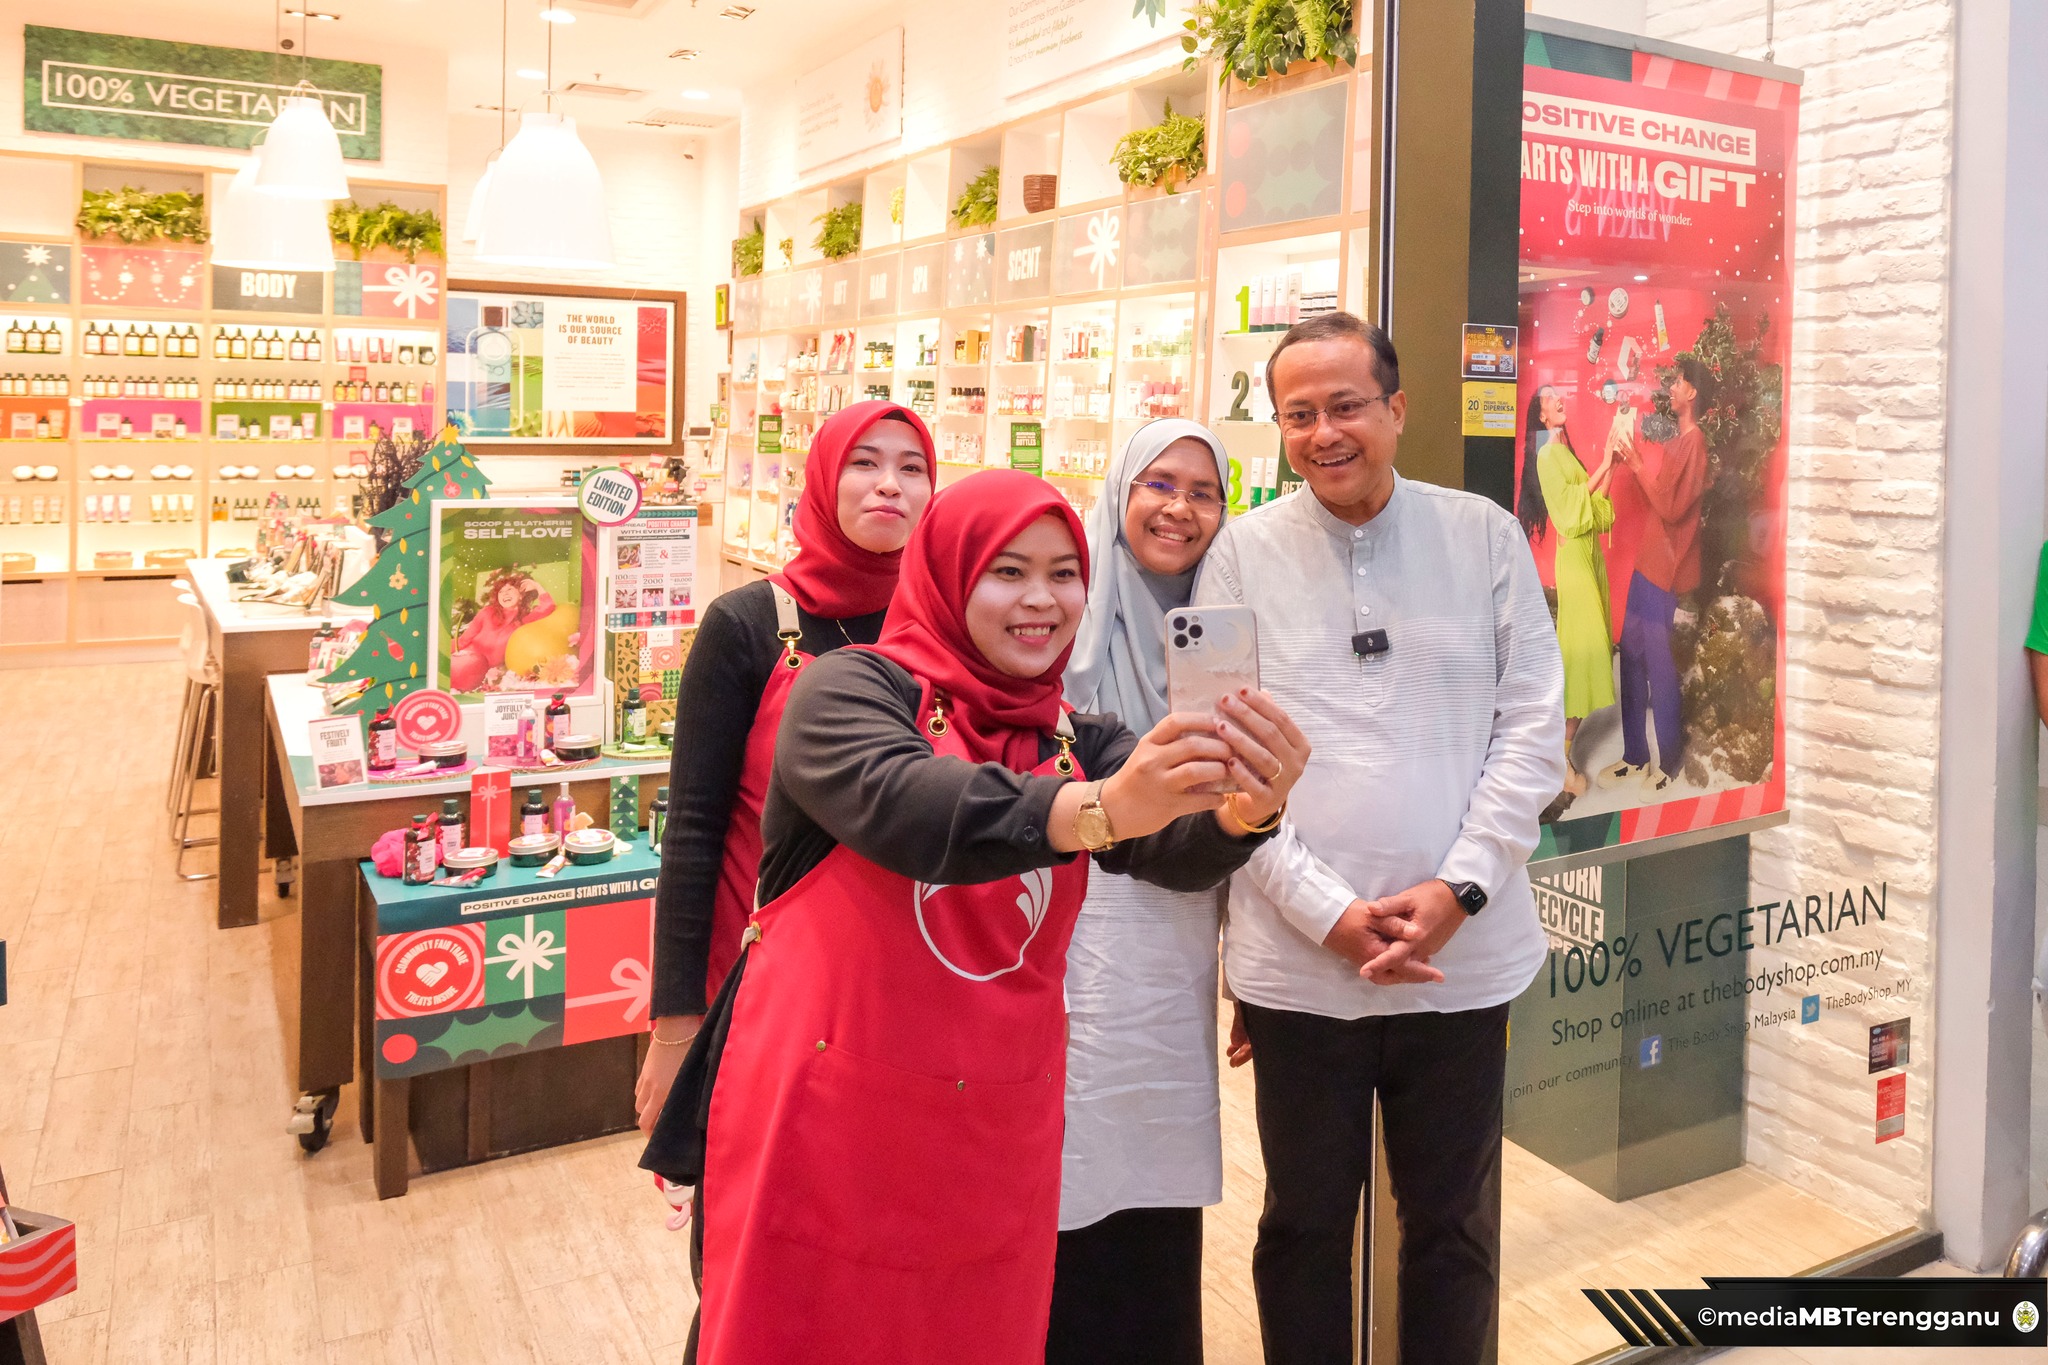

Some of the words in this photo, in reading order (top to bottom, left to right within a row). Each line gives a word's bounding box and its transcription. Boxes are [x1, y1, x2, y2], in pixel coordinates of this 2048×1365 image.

[55, 72, 135, 104] 100%
[144, 81, 356, 126] VEGETAN
[1522, 101, 1635, 136] OSITIVE
[1641, 120, 1751, 156] CHANGE
[1520, 140, 1573, 185] ARTS
[1578, 148, 1632, 193] WITH
[1637, 157, 1649, 195] A
[1654, 160, 1756, 208] GIFT
[1568, 199, 1591, 216] Step
[1594, 202, 1613, 216] into
[1615, 204, 1646, 220] worlds
[1648, 209, 1658, 221] of
[1659, 211, 1693, 227] wonder.
[1008, 245, 1042, 282] SCENT
[240, 271, 297, 299] BODY
[912, 265, 928, 294] SPA
[559, 325, 567, 334] IS
[570, 325, 587, 335] OUR
[590, 325, 622, 335] SOURCE
[567, 314, 583, 324] THE
[585, 315, 615, 325] WORLD
[568, 335, 578, 345] OF
[581, 336, 613, 346] BEAUTY
[1231, 371, 1250, 420] 2
[1468, 400, 1479, 411] 20
[593, 476, 634, 501] LIMITED
[586, 494, 626, 518] EDITION
[463, 527, 573, 540] SELF-LOVE
[464, 520, 501, 528] SCOOP
[514, 519, 559, 527] SLATHER
[647, 520, 670, 528] POSITIVE
[495, 704, 524, 714] JOYFULLY
[319, 729, 350, 741] FESTIVELY
[326, 738, 347, 748] FRUITY
[463, 899, 519, 912] POSITIVE
[522, 890, 573, 904] CHANGE
[576, 883, 608, 898] STARTS
[609, 880, 631, 895] WITH
[632, 879, 639, 891] A
[1550, 932, 1643, 999] 100%
[1656, 882, 1887, 968] VEGETARIAN
[395, 938, 433, 975] COMMUNITY
[434, 938, 450, 951] FAIR
[449, 940, 469, 966] TRADE
[404, 990, 432, 1007] TREATS
[433, 985, 459, 1005] INSIDE
[1552, 1016, 1602, 1046] Shop
[1611, 998, 1670, 1030] online
[1678, 991, 1695, 1010] at
[1703, 949, 1884, 1007] thebodyshop.com.my
[1538, 1075, 1561, 1091] our
[1566, 1054, 1633, 1082] community
[1668, 1035, 1687, 1052] The
[1692, 1028, 1720, 1049] Body
[1724, 1019, 1751, 1039] Shop
[1754, 1007, 1797, 1031] Malaysia
[1825, 978, 1912, 1011] TheBodyShop_MY
